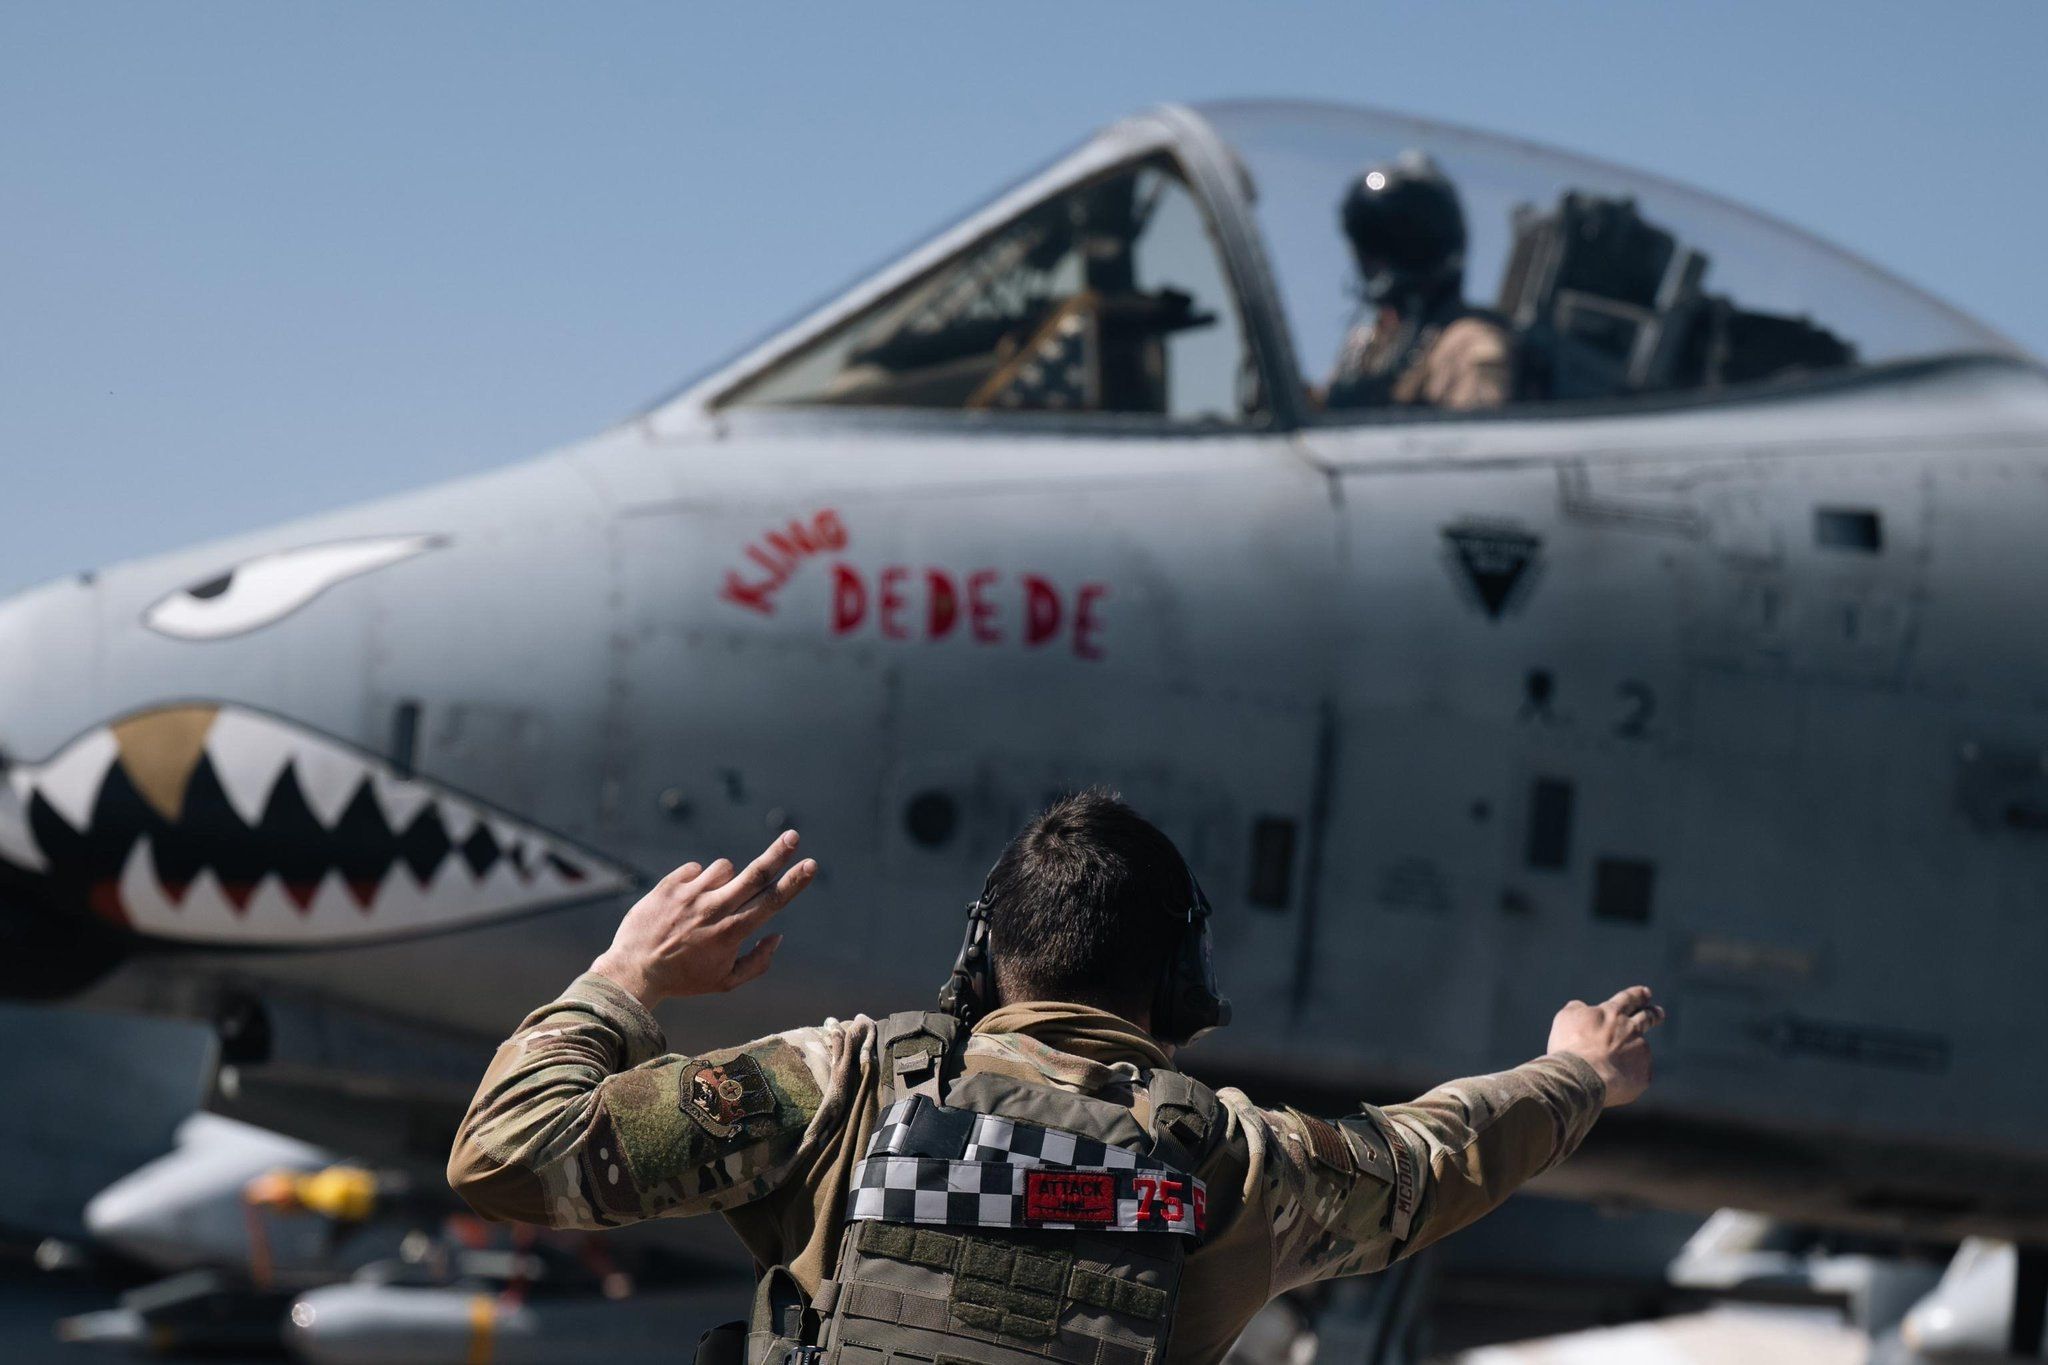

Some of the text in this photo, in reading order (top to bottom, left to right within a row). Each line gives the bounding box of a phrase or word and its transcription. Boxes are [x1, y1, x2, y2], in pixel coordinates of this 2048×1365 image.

[719, 509, 849, 616] KING
[1039, 1180, 1104, 1197] ATTACK
[1133, 1177, 1185, 1222] 75
